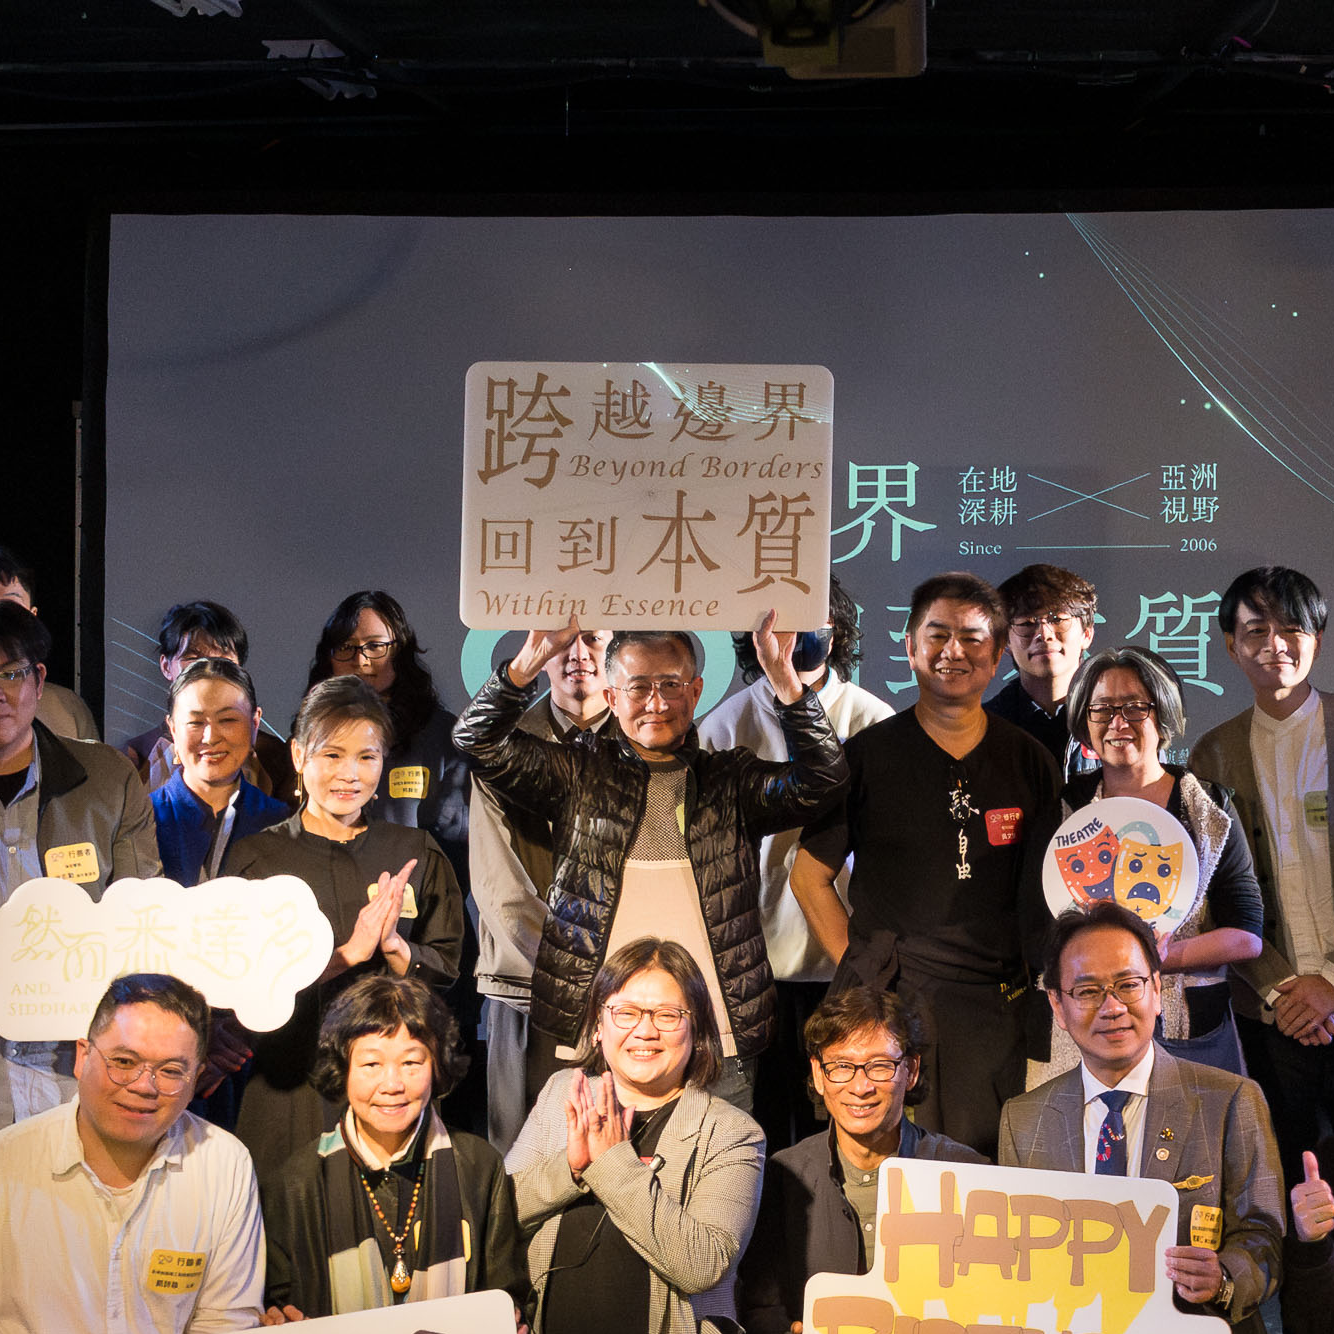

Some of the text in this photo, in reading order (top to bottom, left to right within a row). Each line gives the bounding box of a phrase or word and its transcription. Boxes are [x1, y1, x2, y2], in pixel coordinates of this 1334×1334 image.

[477, 372, 821, 489] 跨越邊界
[570, 453, 823, 485] Beyond Borders
[958, 466, 1018, 494] 在地
[1159, 463, 1218, 491] 亞洲
[830, 461, 937, 563] 界
[958, 497, 1018, 526] 深耕
[1159, 496, 1219, 524] 視野
[480, 490, 815, 595] 回到本質
[959, 538, 1218, 555] Since 2006
[477, 590, 720, 617] Within Essence
[1055, 817, 1103, 847] THEATRE
[6, 1001, 97, 1016] SIDDHAR
[880, 1167, 1171, 1293] HAPPY
